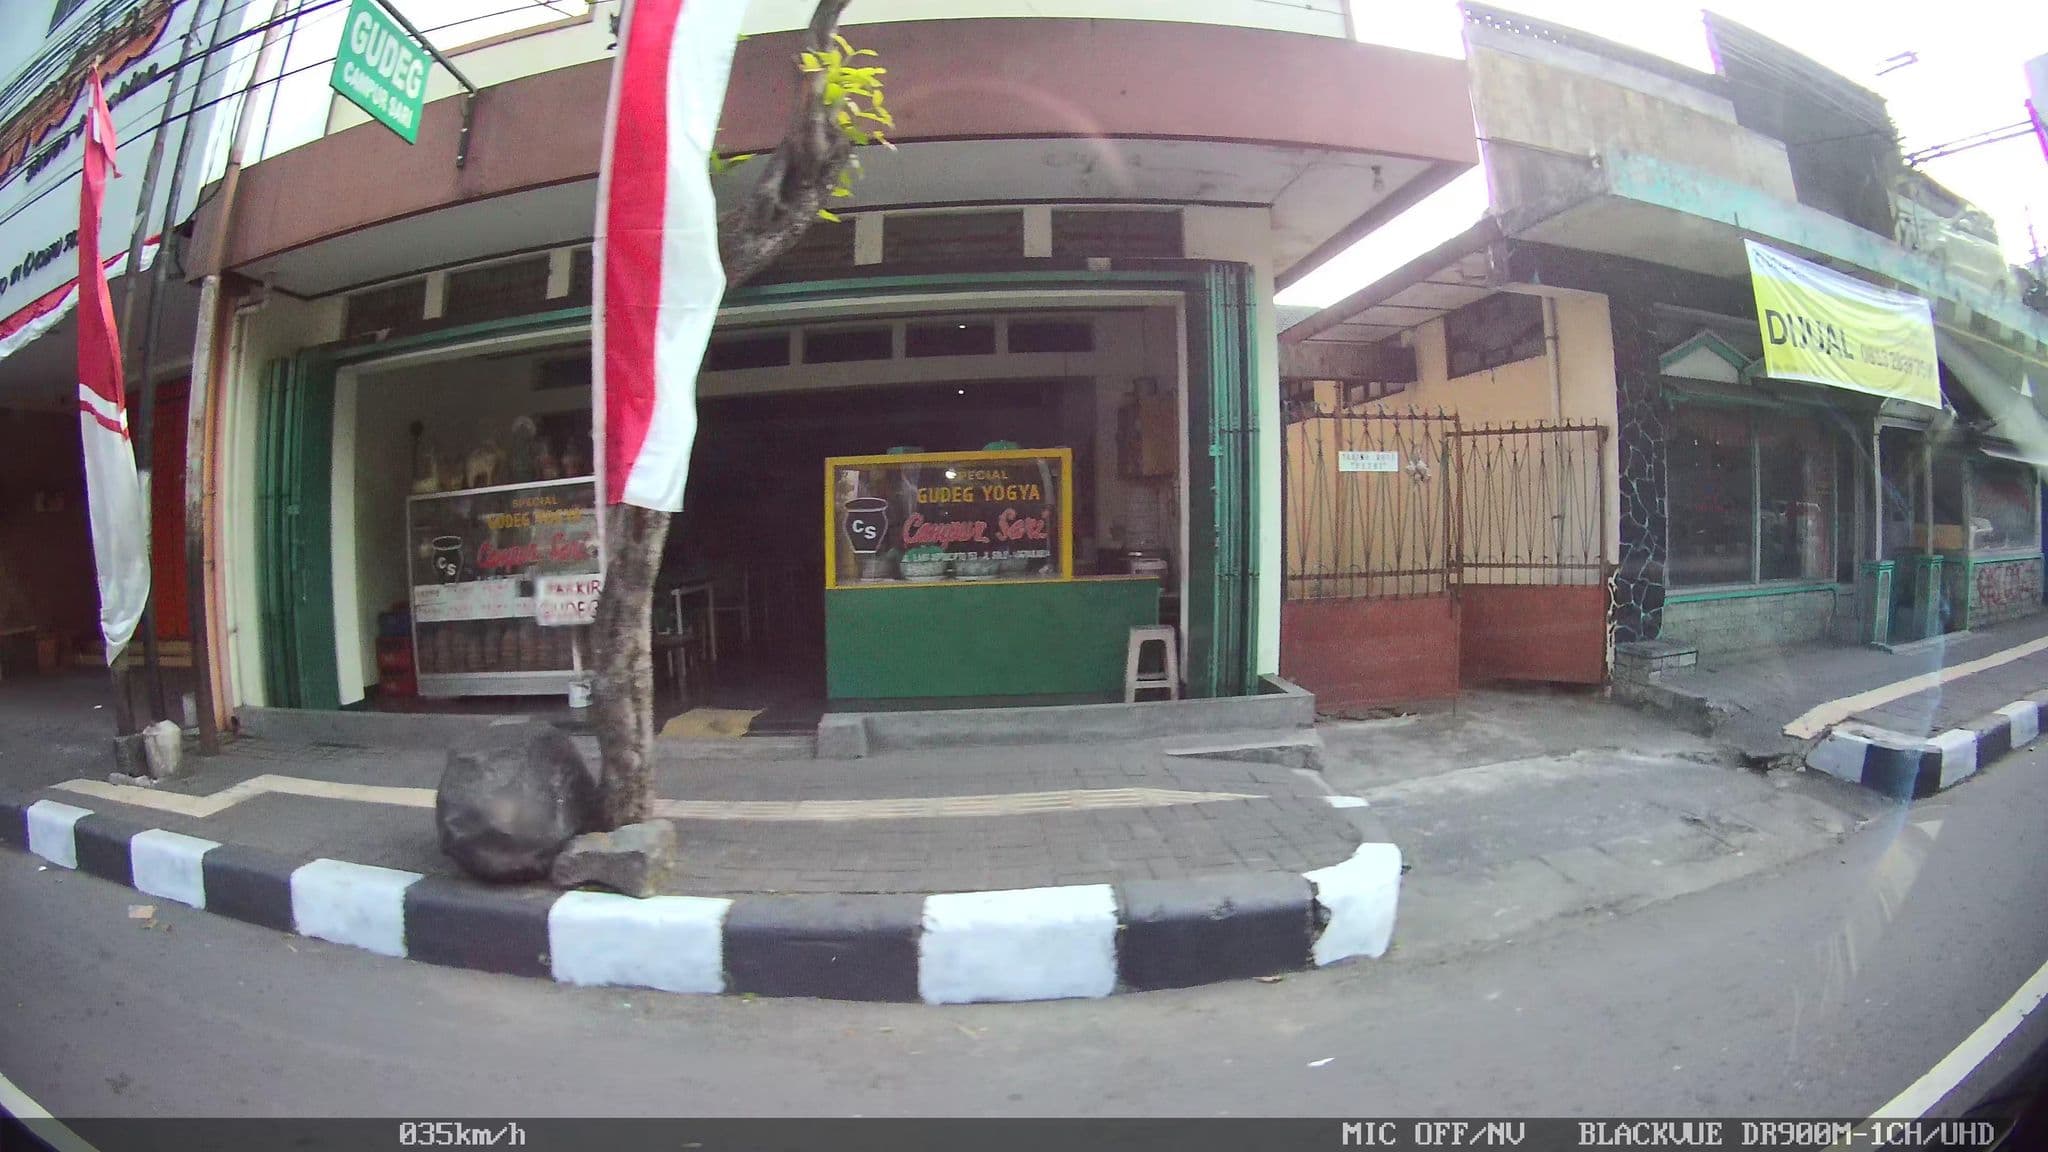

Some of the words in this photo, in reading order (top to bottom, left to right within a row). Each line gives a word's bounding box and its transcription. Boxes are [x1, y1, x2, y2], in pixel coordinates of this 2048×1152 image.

[351, 11, 424, 99] GUDEG
[343, 61, 389, 112] CAMPUR
[387, 96, 413, 129] SARI
[917, 486, 974, 504] GUDEG
[983, 484, 1041, 501] YOGYA
